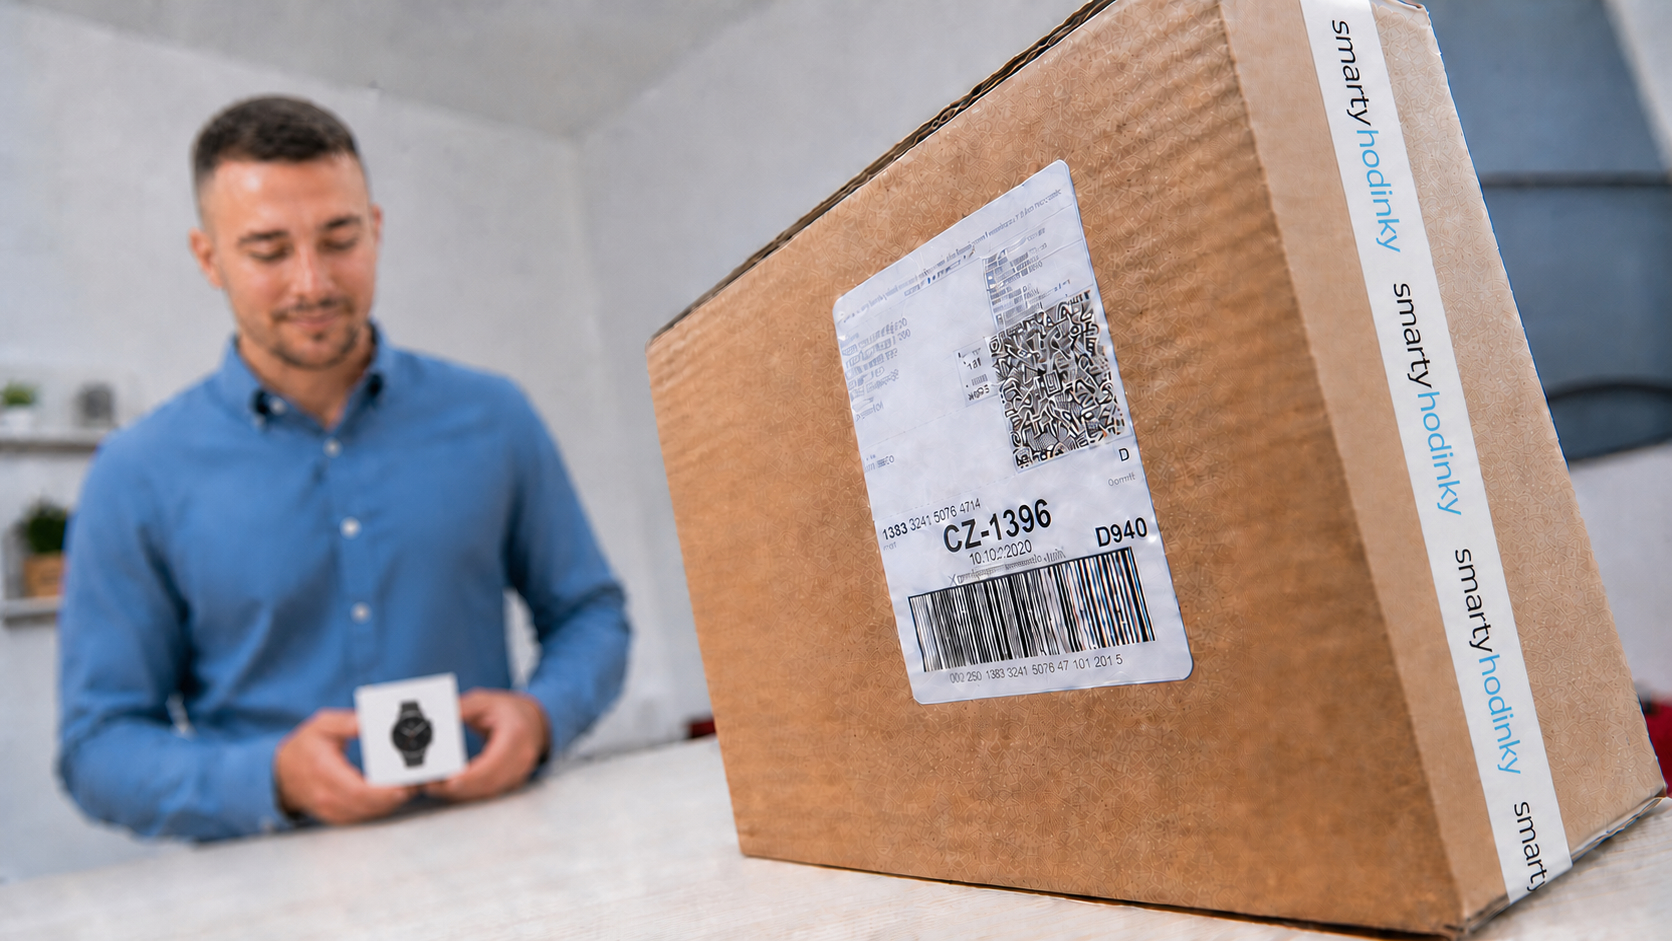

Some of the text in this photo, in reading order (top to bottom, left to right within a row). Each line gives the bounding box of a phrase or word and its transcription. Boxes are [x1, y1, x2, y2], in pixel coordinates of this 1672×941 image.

[1118, 447, 1130, 462] D
[882, 497, 981, 540] 1383 3241 5076 4714
[943, 498, 1052, 553] CZ-1396
[1095, 517, 1148, 548] D940
[949, 671, 965, 684] 002
[985, 668, 1006, 680] 1383
[1007, 665, 1029, 678] 3241
[1032, 660, 1056, 676] 5076
[1057, 659, 1069, 671] 47
[1073, 657, 1091, 670] 101
[1094, 654, 1113, 668] 201
[1116, 653, 1123, 665] 5
